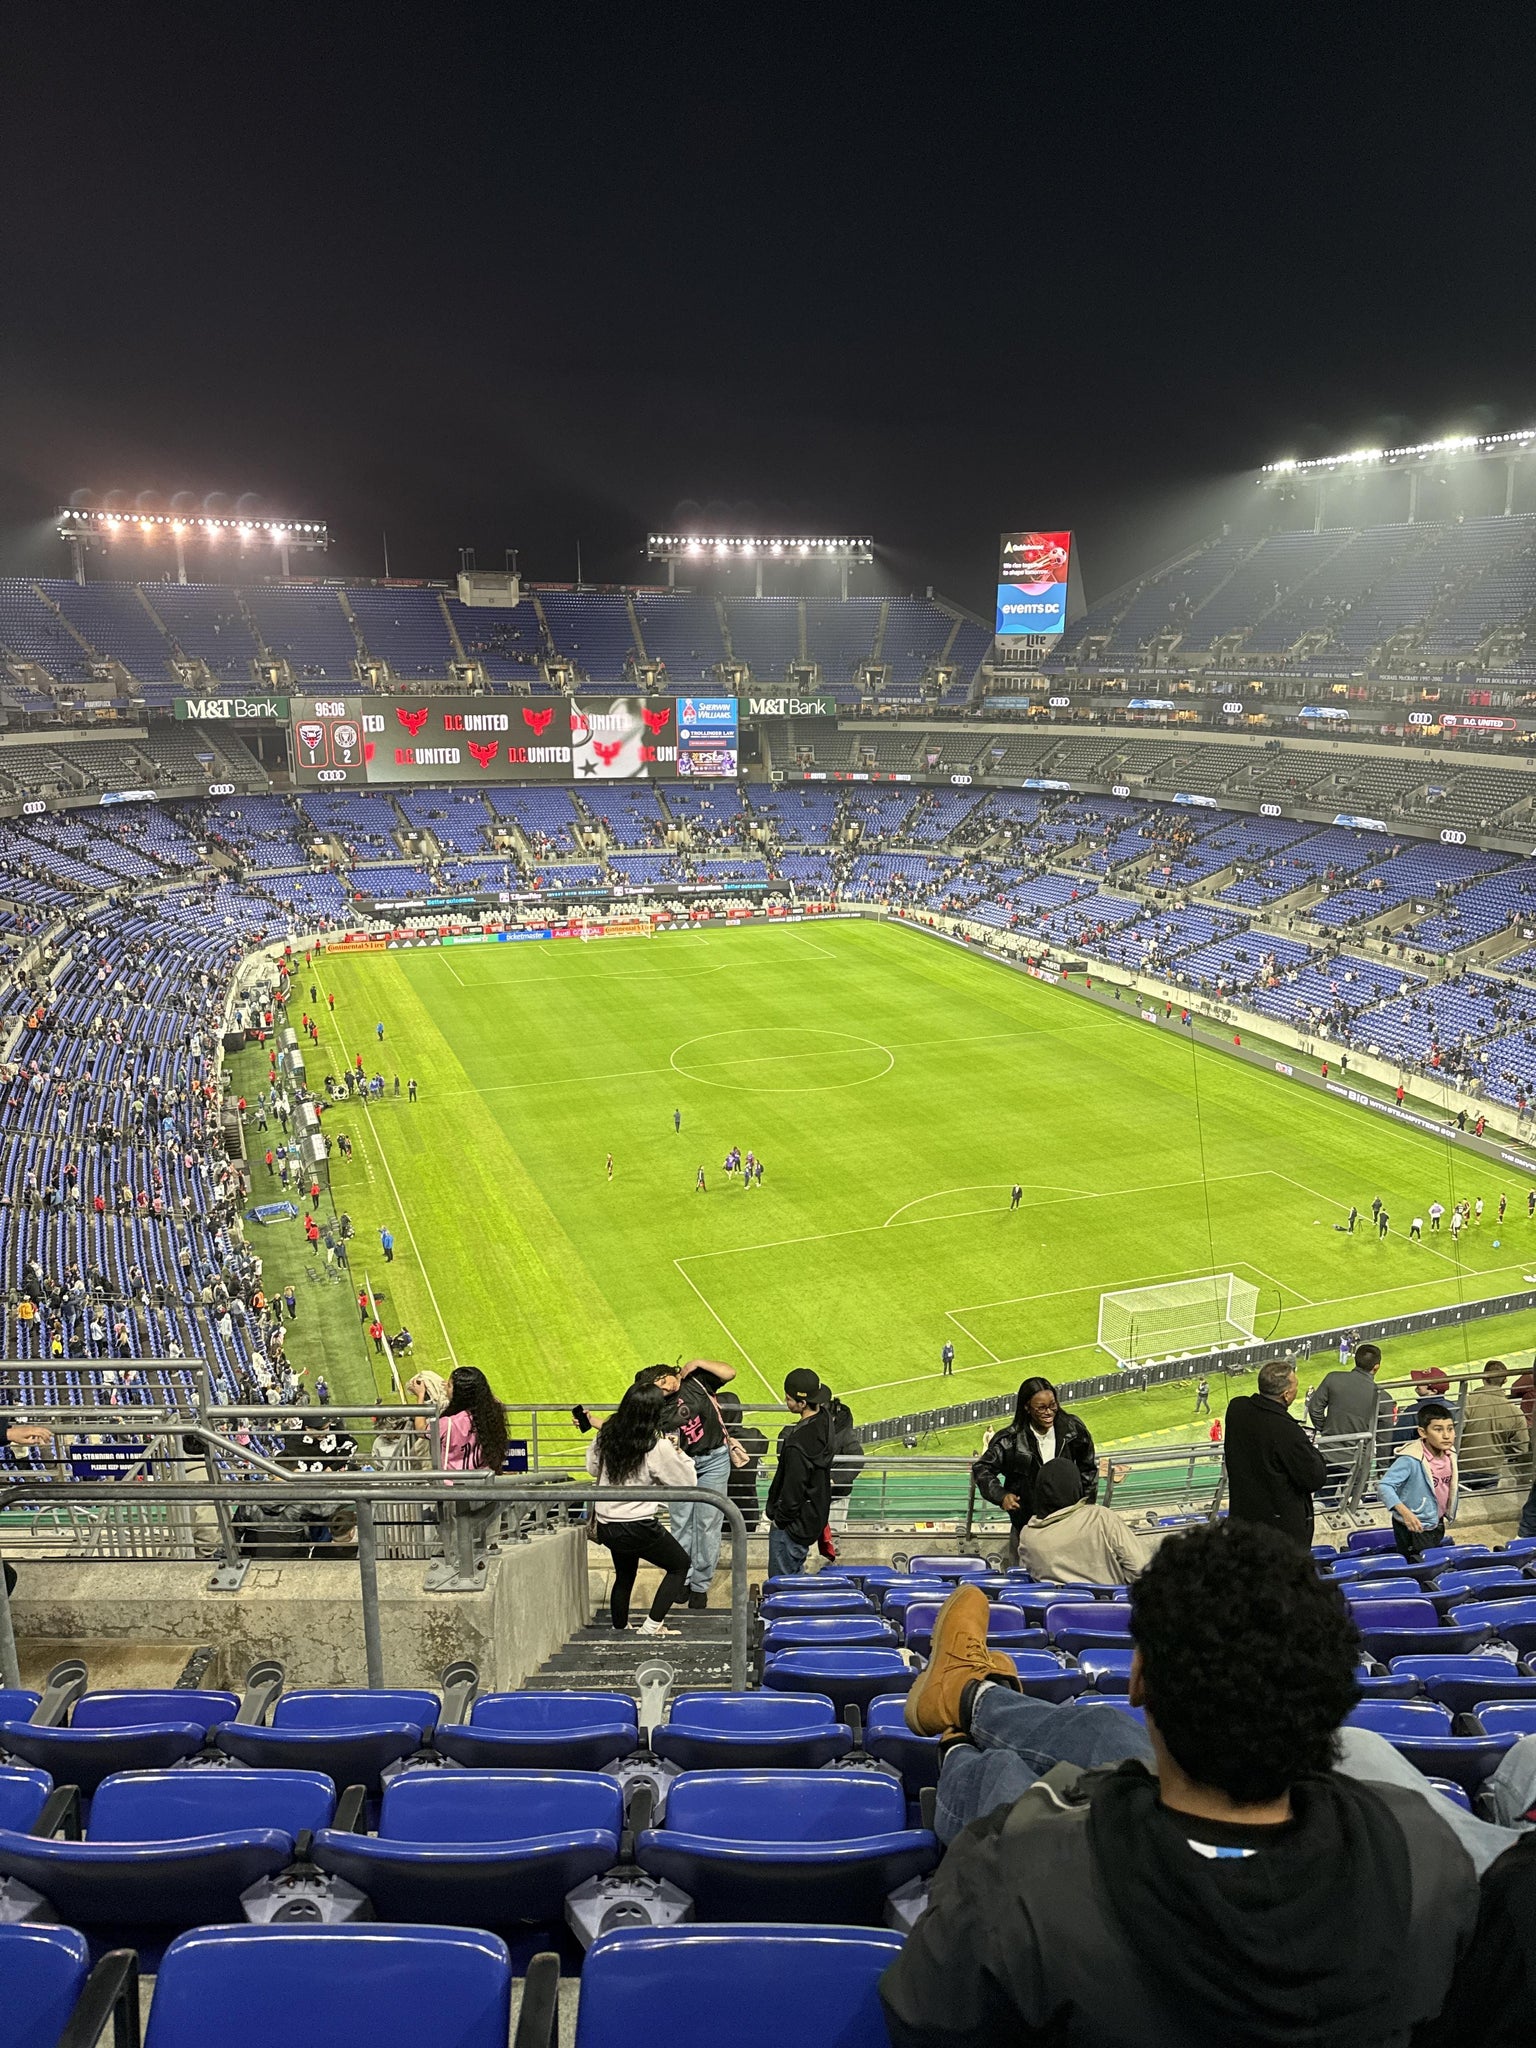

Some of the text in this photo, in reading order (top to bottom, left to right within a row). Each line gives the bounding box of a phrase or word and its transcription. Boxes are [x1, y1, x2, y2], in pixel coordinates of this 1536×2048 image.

[186, 698, 278, 719] M&T Bank
[315, 702, 346, 717] 96:06
[748, 698, 827, 715] M&T Bank
[1477, 718, 1504, 728] UNITED
[309, 749, 316, 765] 1
[343, 749, 352, 764] 2
[506, 932, 545, 941] ticketmaster
[555, 930, 571, 938] Audi
[327, 942, 364, 952] Continental
[1348, 1090, 1369, 1106] BIG
[1369, 1099, 1387, 1112] WITH
